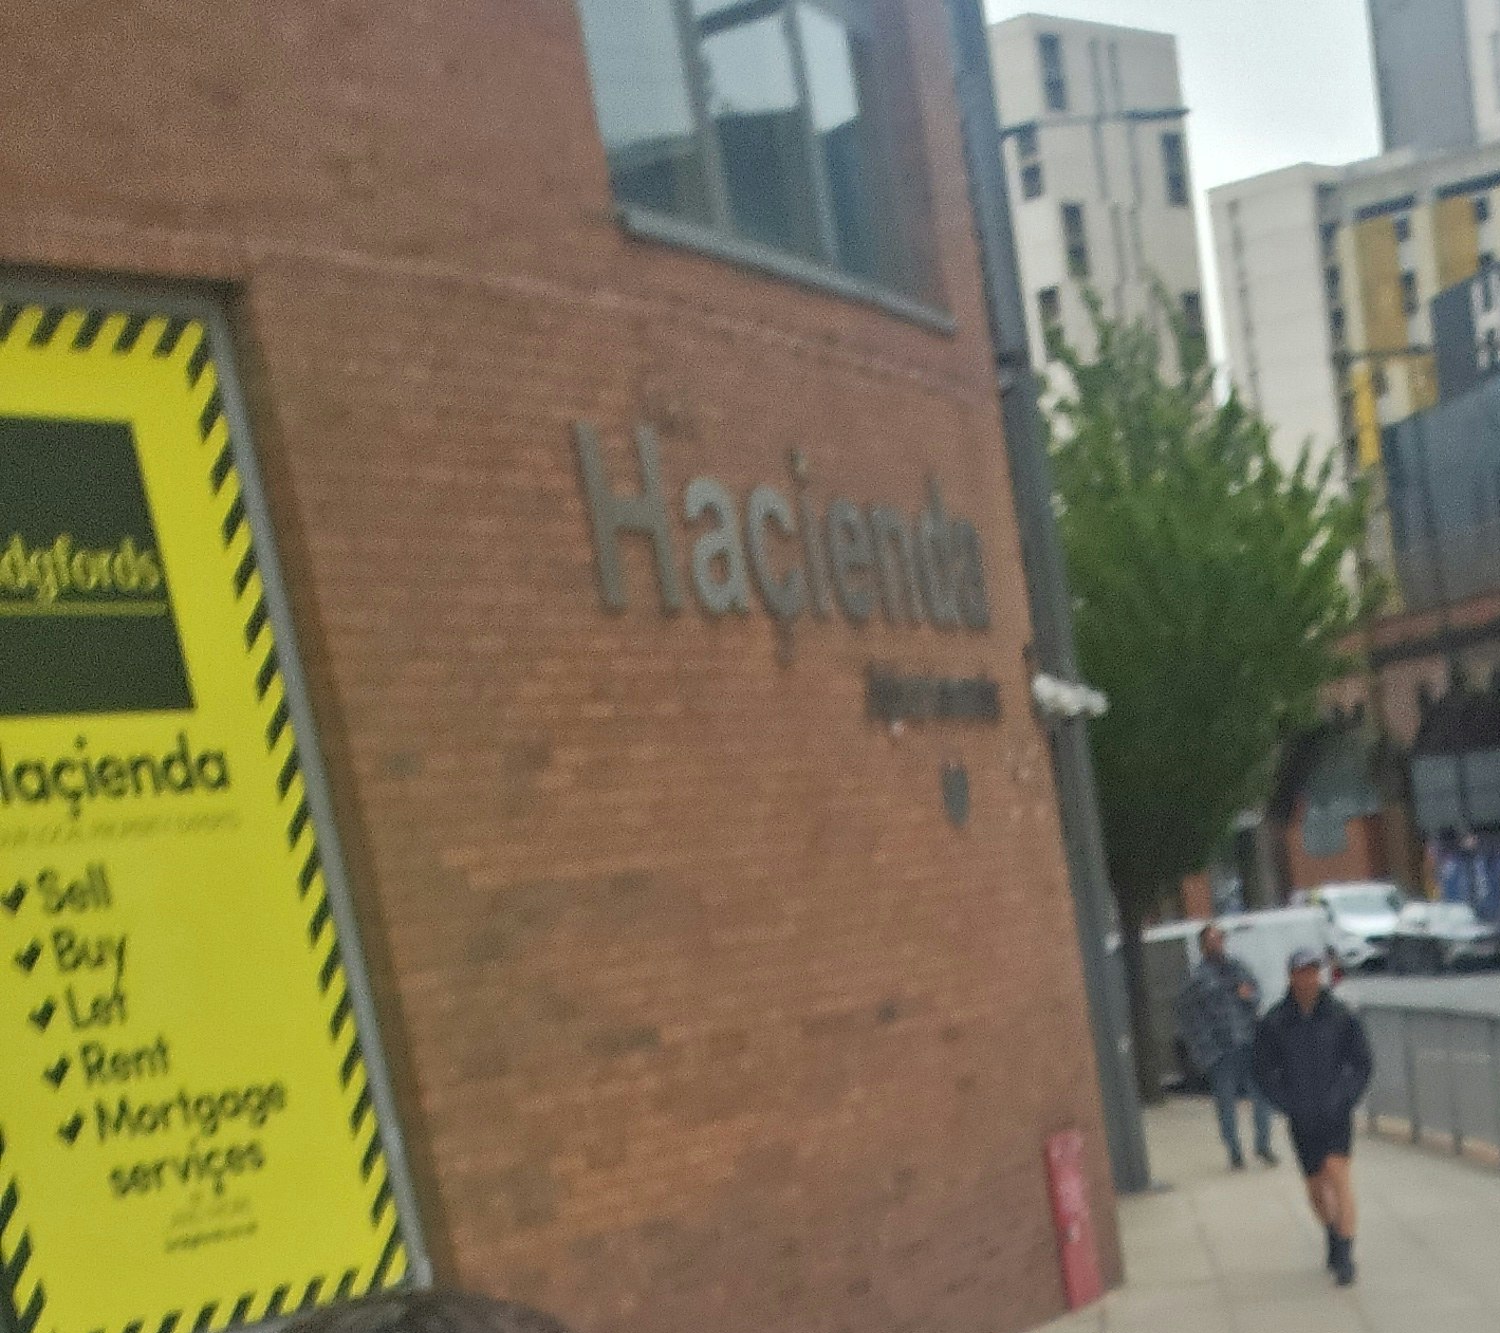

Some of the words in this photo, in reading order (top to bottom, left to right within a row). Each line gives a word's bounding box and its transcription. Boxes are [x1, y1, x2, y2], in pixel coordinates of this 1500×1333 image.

[0, 730, 230, 822] açienda
[36, 862, 112, 915] Sell
[51, 926, 127, 995] Buy
[65, 982, 127, 1032] Let
[79, 1034, 169, 1084] Rent
[94, 1079, 288, 1144] Mortgage
